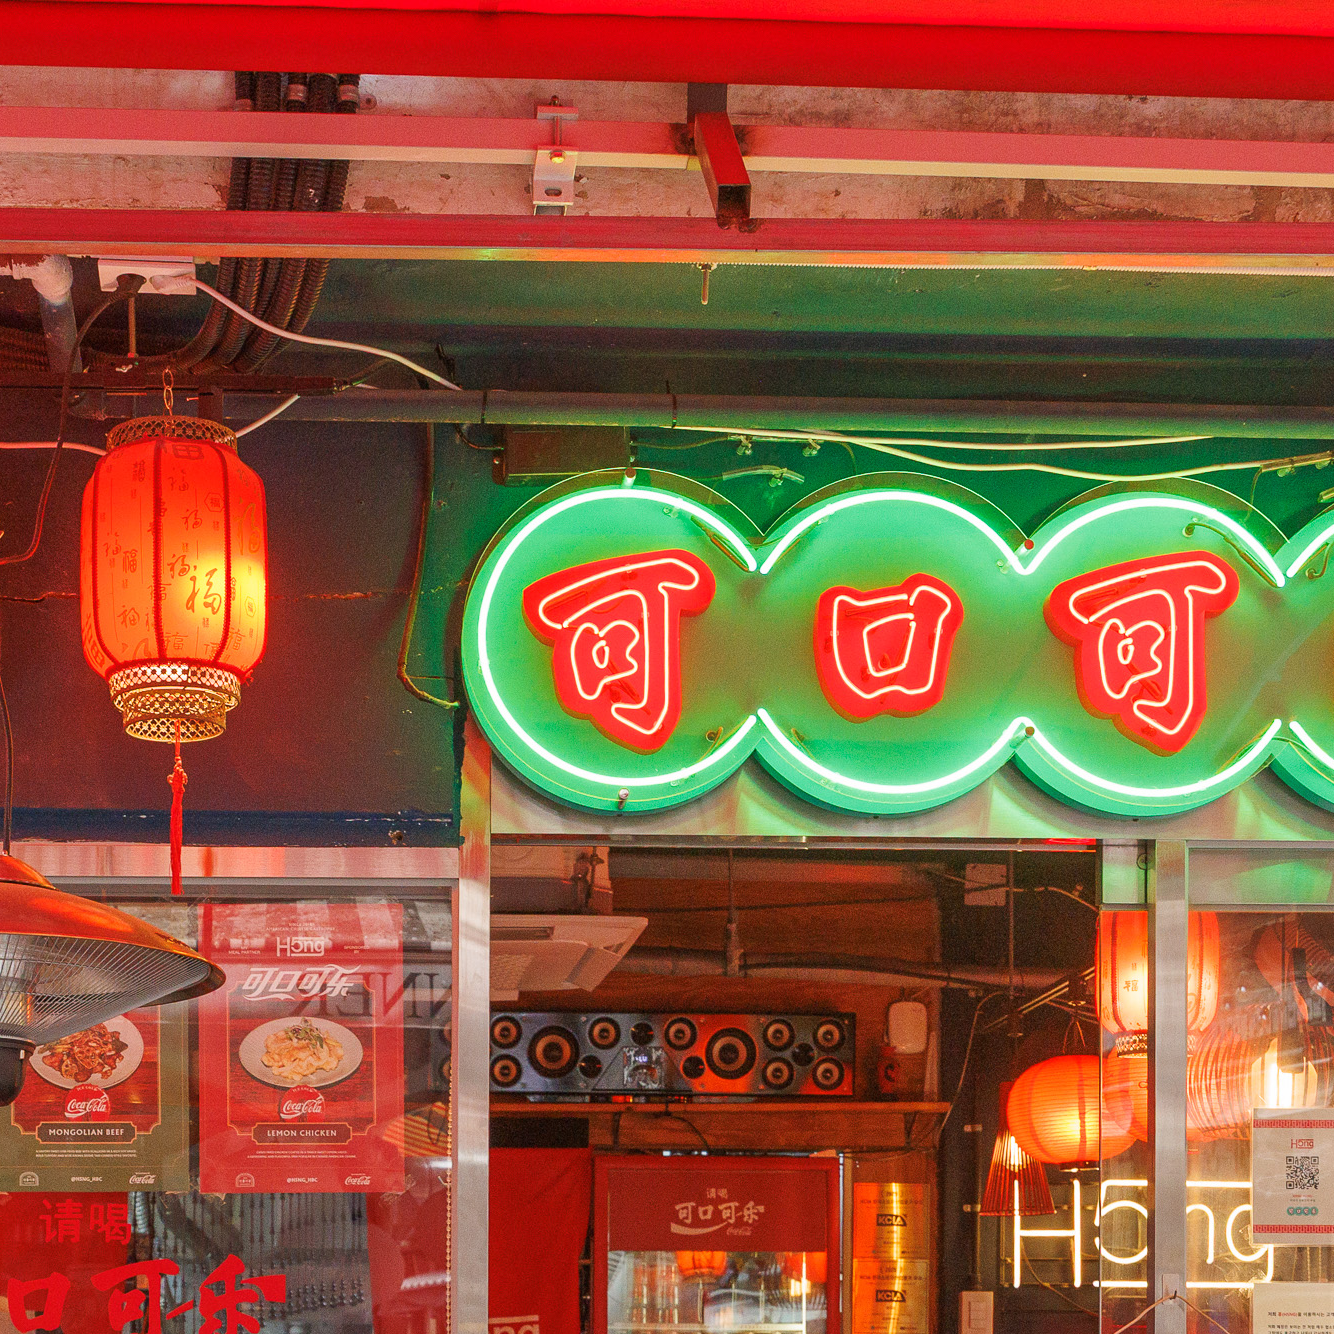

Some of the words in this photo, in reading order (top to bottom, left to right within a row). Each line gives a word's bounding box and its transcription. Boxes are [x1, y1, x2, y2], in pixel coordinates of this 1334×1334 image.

[241, 963, 362, 1001] 可口可乐
[267, 1129, 297, 1137] LEMON
[299, 1129, 337, 1137] CHICKEN
[39, 1198, 133, 1246] 请喝
